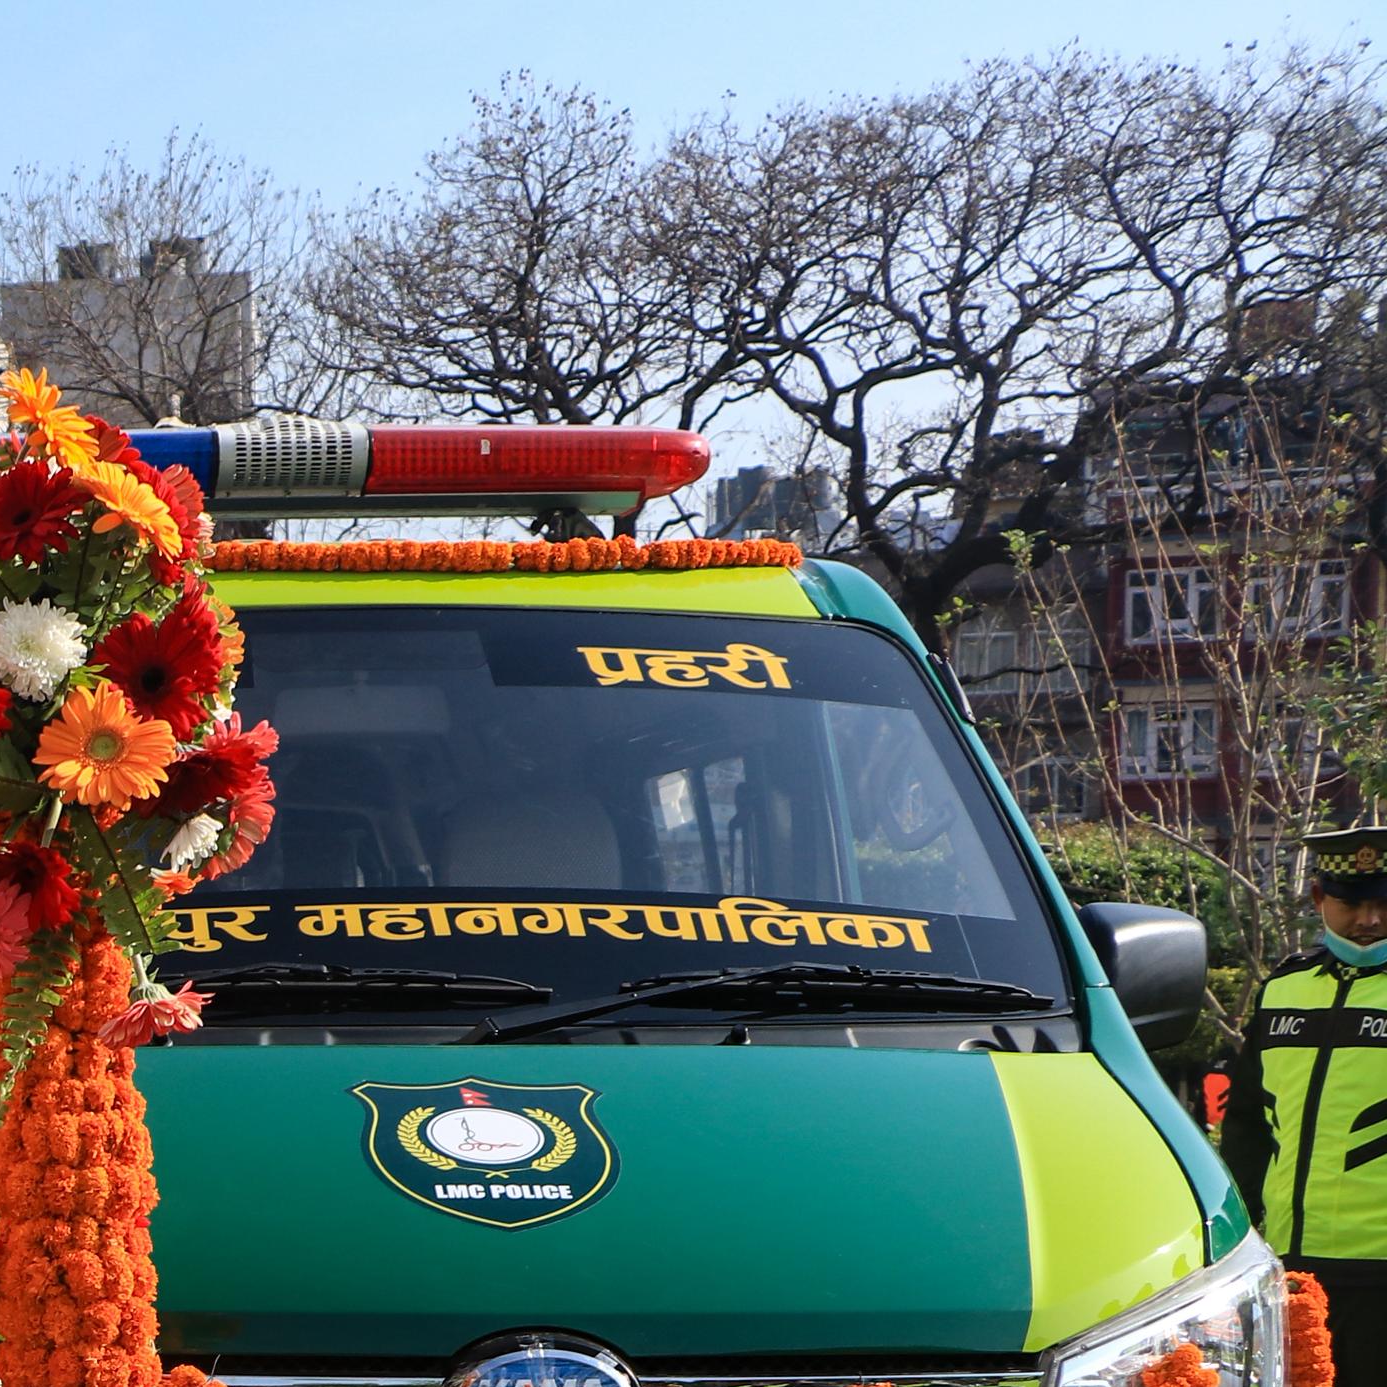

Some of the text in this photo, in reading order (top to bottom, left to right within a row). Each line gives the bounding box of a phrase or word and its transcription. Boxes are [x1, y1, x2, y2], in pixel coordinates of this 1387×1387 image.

[577, 643, 792, 689] प्रहरी
[295, 897, 933, 954] महानगरपालिका
[1269, 1016, 1387, 1038] LMC POL
[434, 1184, 573, 1200] LMC POLICE
